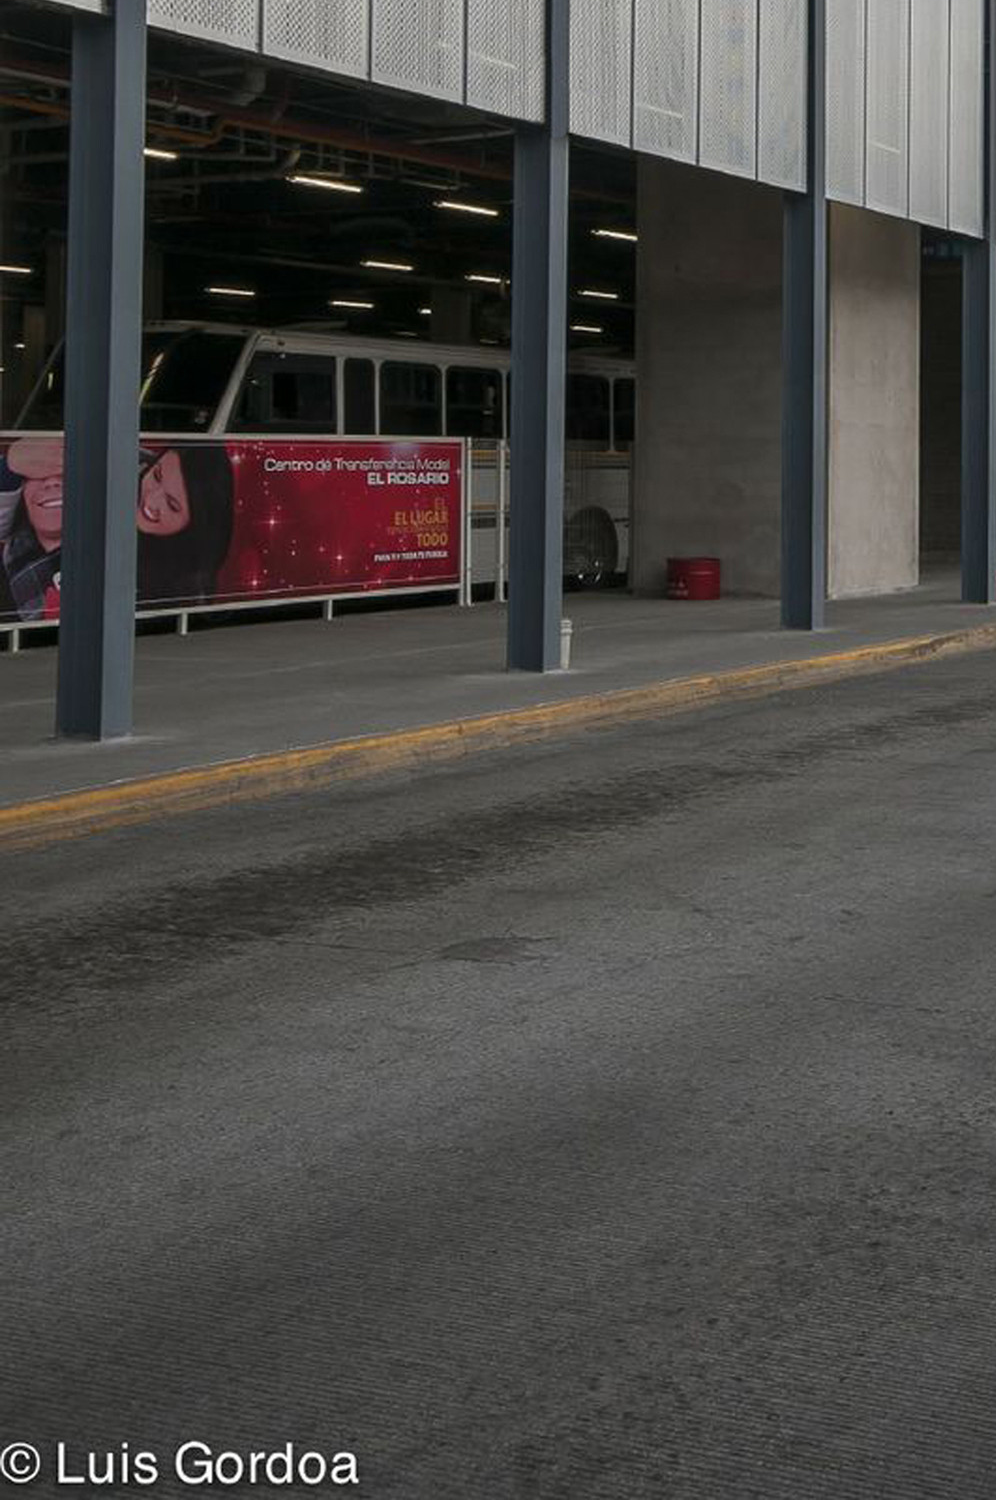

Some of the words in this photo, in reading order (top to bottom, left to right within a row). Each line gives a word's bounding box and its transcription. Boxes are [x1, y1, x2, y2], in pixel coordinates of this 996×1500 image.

[264, 458, 314, 471] Centro
[315, 458, 332, 471] de
[334, 457, 415, 471] Transferencia
[366, 472, 385, 485] EL
[387, 472, 449, 485] ROSARIO
[394, 510, 408, 526] EL
[410, 508, 448, 525] LUGAR
[416, 532, 449, 547] TODO
